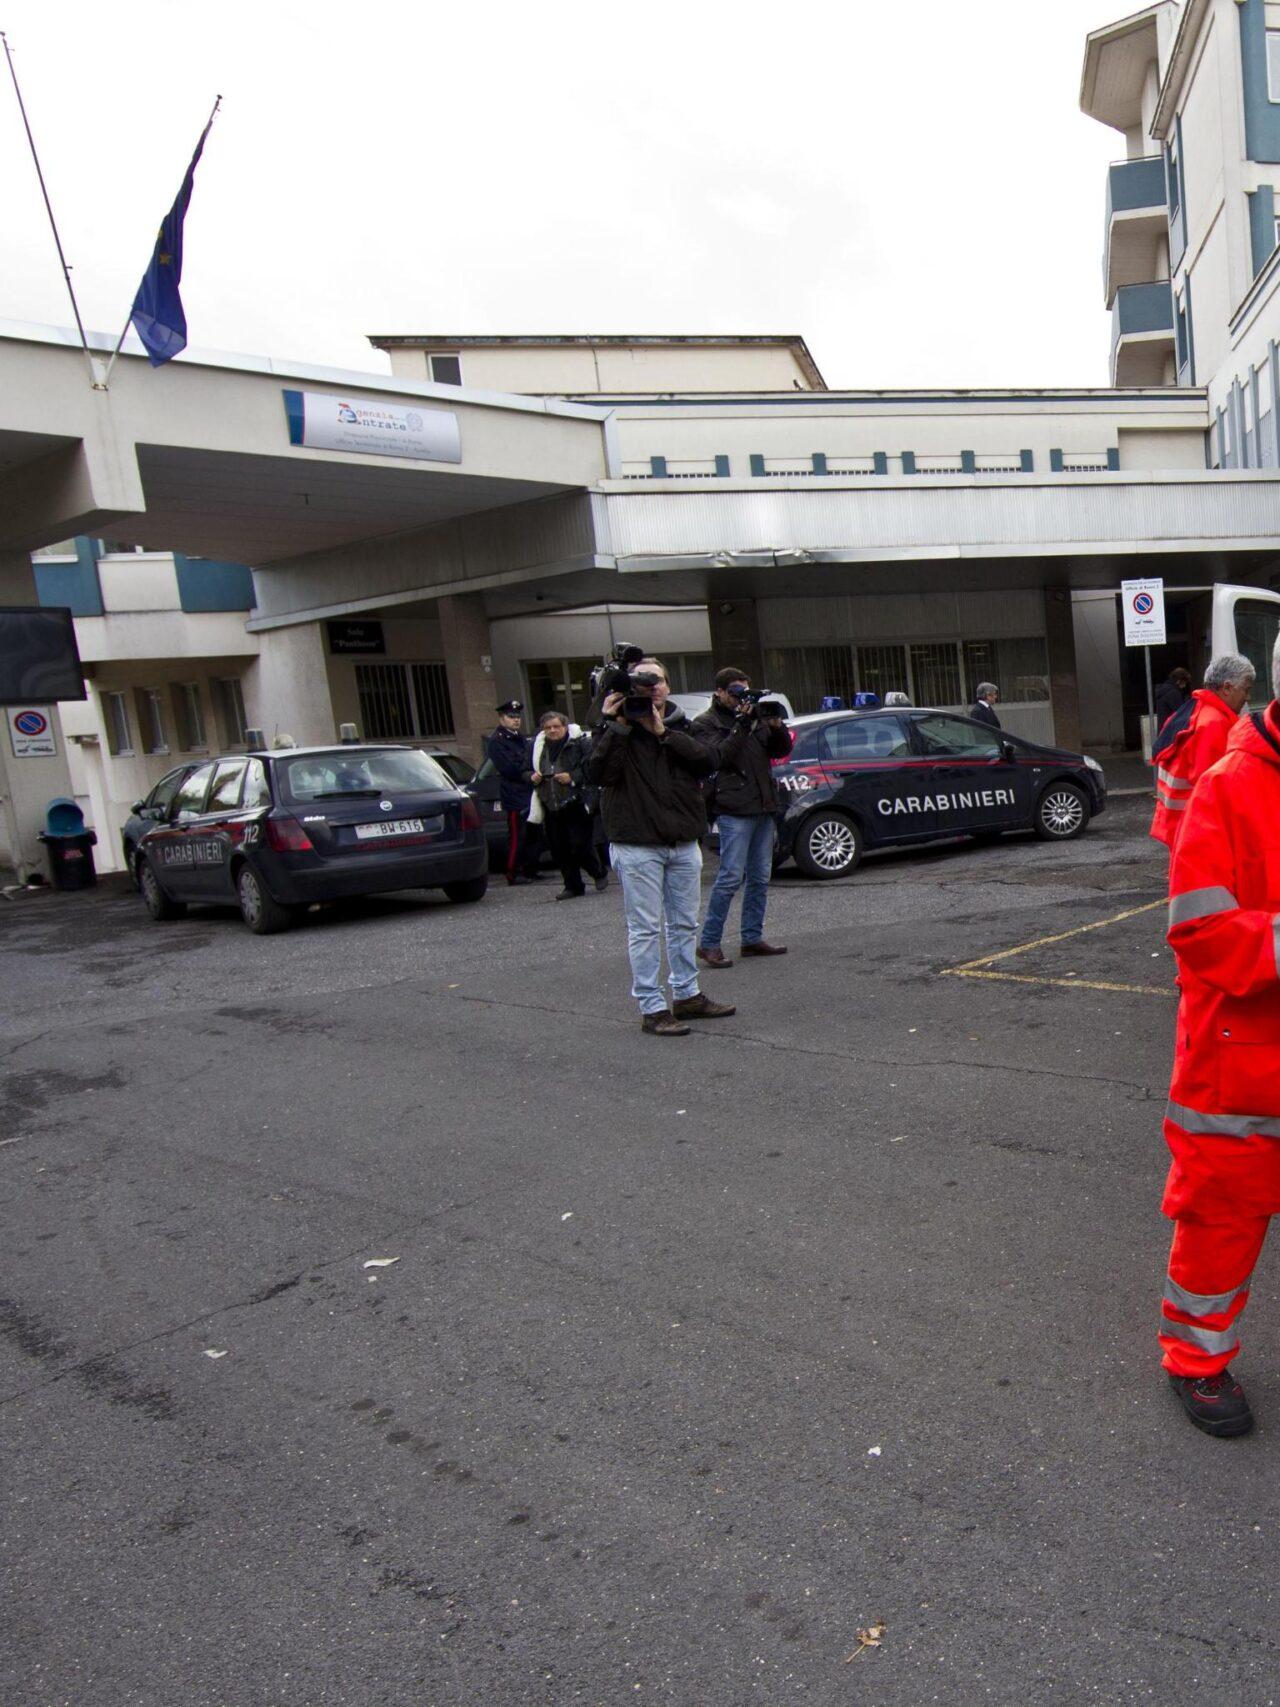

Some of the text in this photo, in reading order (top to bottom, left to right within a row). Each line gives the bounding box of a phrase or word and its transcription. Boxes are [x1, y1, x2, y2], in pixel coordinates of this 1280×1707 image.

[780, 775, 812, 792] 112
[877, 788, 1015, 816] CARABINIERI
[243, 824, 260, 844] 112
[164, 841, 223, 864] CARABINIERI
